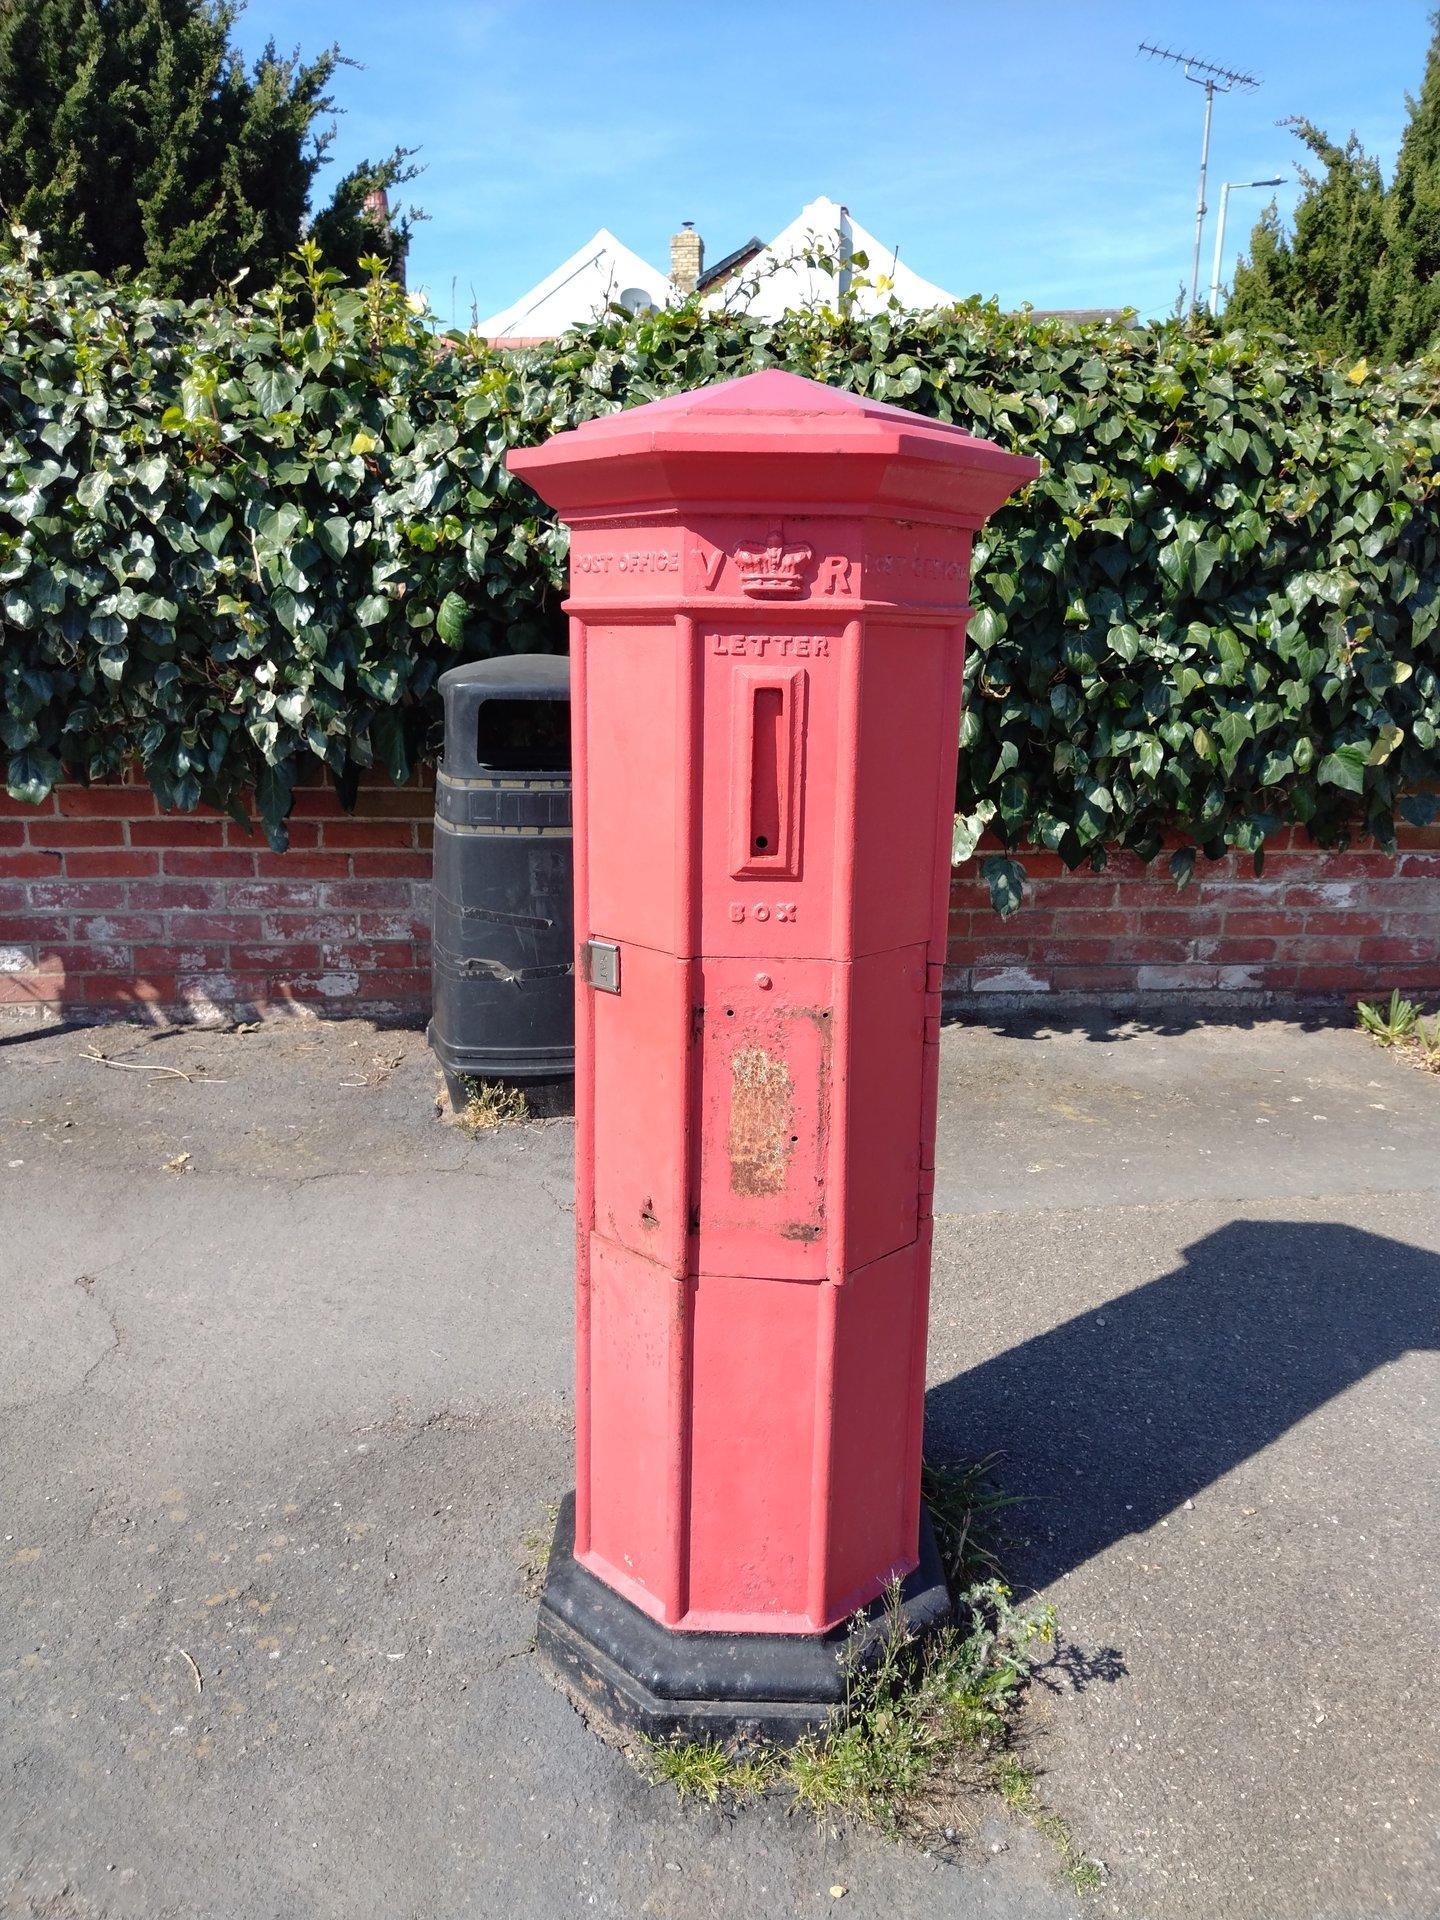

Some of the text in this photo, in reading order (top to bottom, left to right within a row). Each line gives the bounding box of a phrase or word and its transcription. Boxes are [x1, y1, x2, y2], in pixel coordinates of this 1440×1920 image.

[573, 551, 679, 574] POST OFFICE
[691, 547, 852, 595] V R
[712, 634, 830, 658] LETTER
[468, 792, 573, 822] LITT
[729, 902, 798, 924] BOX
